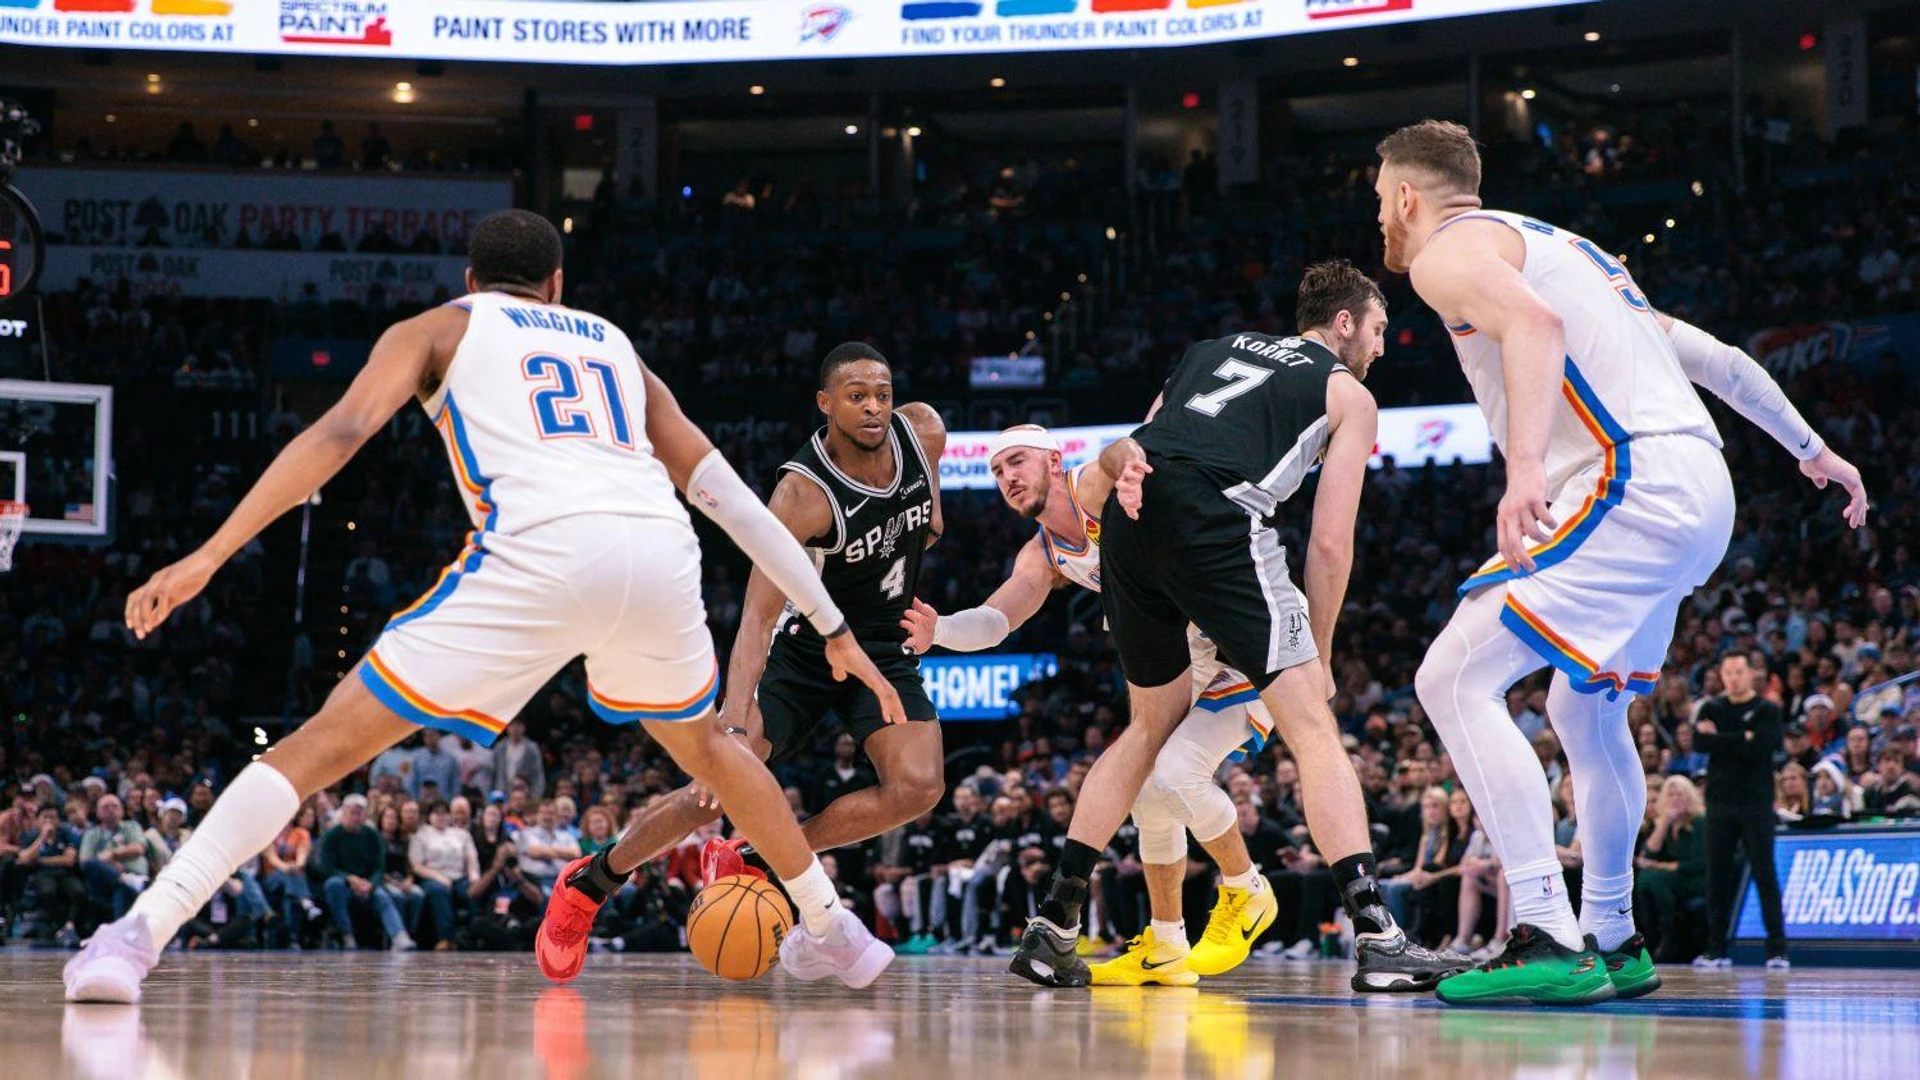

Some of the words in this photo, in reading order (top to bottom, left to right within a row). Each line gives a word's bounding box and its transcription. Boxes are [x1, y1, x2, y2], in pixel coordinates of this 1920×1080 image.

[66, 18, 121, 39] PAINT
[129, 21, 205, 40] COLORS
[212, 23, 235, 41] AT
[280, 14, 364, 32] PAINT
[434, 16, 503, 39] PAINT
[513, 18, 607, 43] STORES
[616, 20, 675, 43] WITH
[682, 17, 751, 42] MORE
[902, 26, 945, 44] FIND
[951, 24, 1002, 43] YOUR
[1009, 20, 1097, 41] THUNDER
[1103, 20, 1158, 38] PAINT
[1165, 13, 1238, 35] COLORS
[1243, 9, 1264, 27] AT
[64, 199, 131, 236] POST
[175, 202, 229, 235] OAK
[240, 203, 335, 237] PARTY
[501, 306, 605, 343] WIGGINS
[1231, 335, 1315, 368] KORNET
[520, 351, 636, 452] 21
[1184, 357, 1276, 418] 7
[880, 555, 906, 600] 4
[922, 664, 1019, 710] HOME!
